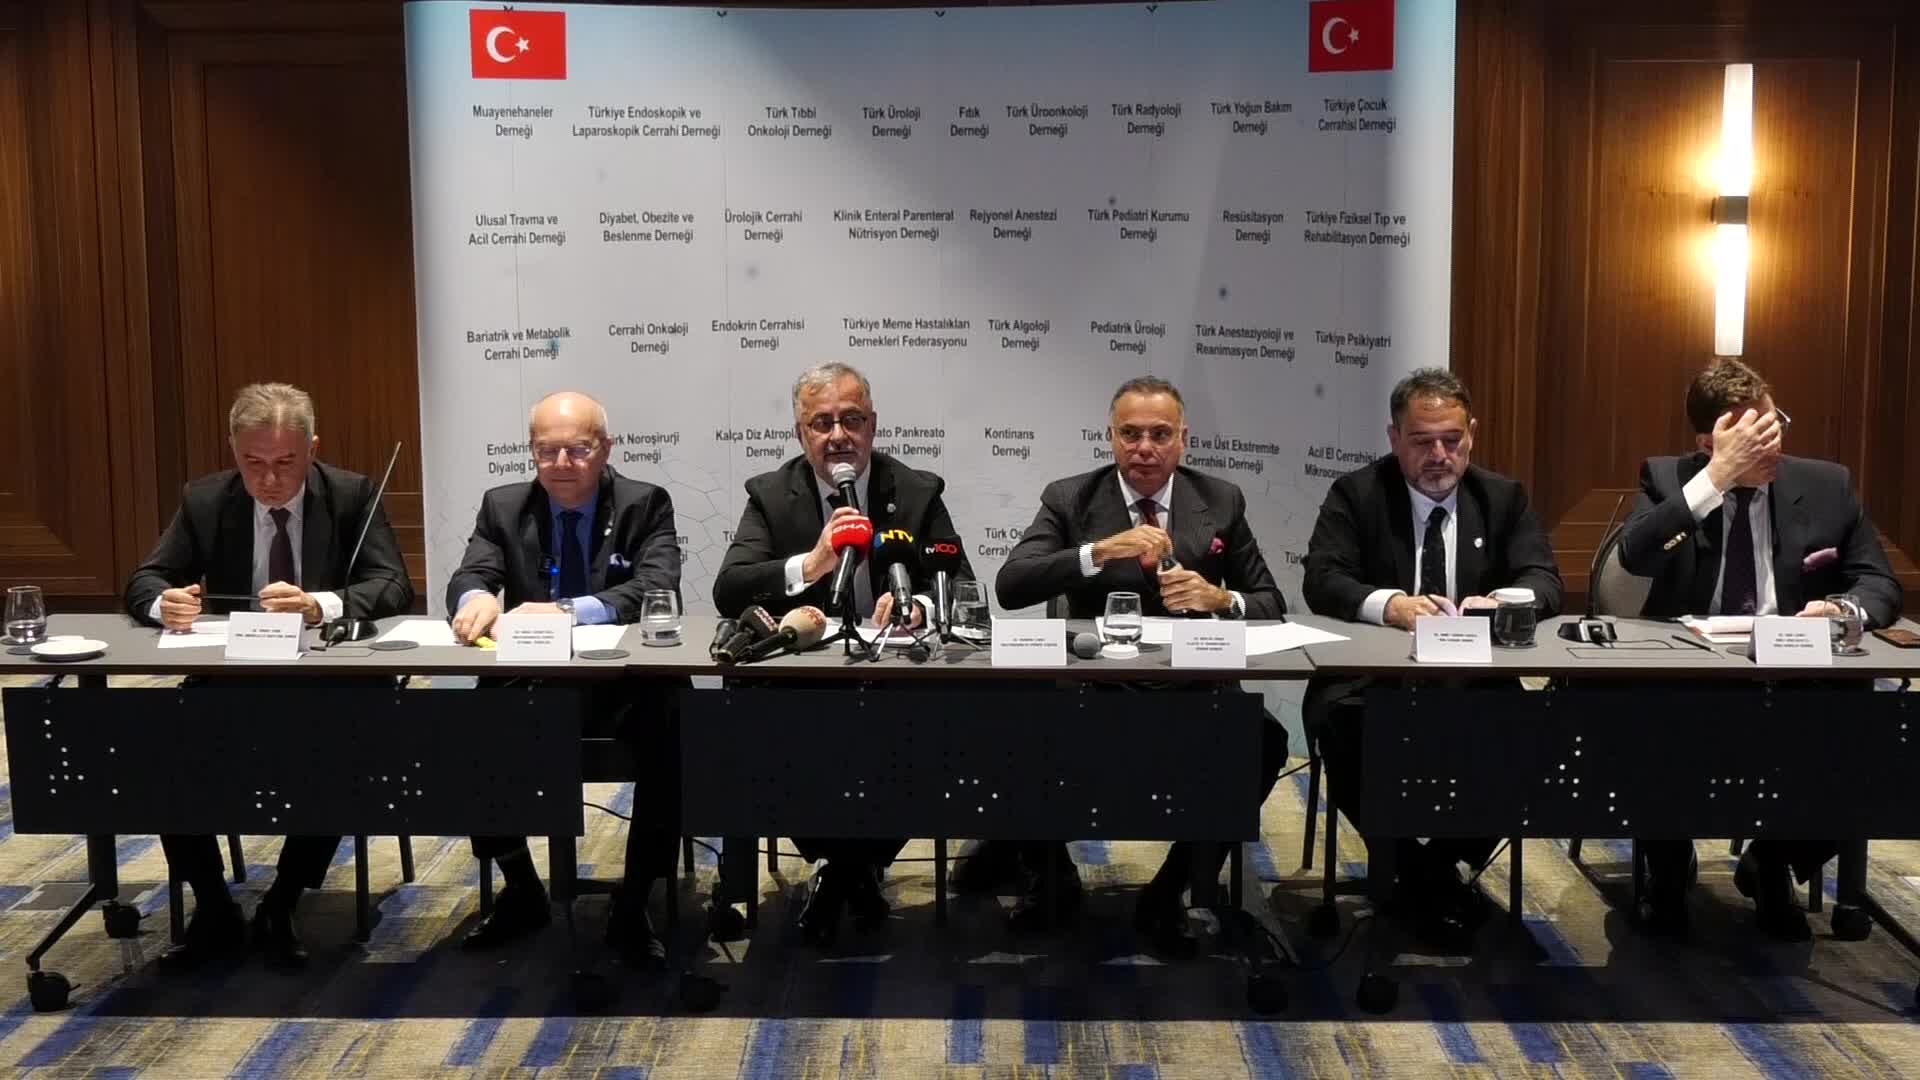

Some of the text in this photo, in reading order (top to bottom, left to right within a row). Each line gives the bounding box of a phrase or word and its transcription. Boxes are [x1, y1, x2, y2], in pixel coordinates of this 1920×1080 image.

[473, 105, 553, 120] Muayenehaneler
[588, 106, 701, 120] Türkiye Endoskopik ve
[766, 107, 788, 118] Türk
[863, 105, 920, 121] Türk Üroloji
[1006, 103, 1088, 120] Türk Üroonkoloji
[1112, 104, 1181, 118] Türk Radyoloji
[1210, 103, 1232, 114] Türk
[1234, 102, 1262, 117] Yoğun
[1324, 98, 1387, 114] Türkiye Çocuk
[496, 124, 533, 139] Derneği
[573, 125, 720, 139] Laparoskopik Cerrahi Derneği
[748, 124, 831, 140] Onkoloji Derneği
[872, 125, 911, 139] Derneği
[950, 124, 989, 139] Derneği
[1029, 124, 1068, 138] Derneği
[1128, 122, 1164, 137] Derneği
[1233, 121, 1267, 136] Derneği
[1318, 118, 1396, 133] Cerrahisi Derneği
[476, 214, 558, 226] Ulusal Travma ve
[600, 211, 694, 226] Diyabet, Obezite ve
[725, 208, 802, 225] Ürolojik Cerrahi
[834, 209, 954, 221] Klinik Enteral Parenteral
[1015, 208, 1057, 221] Anestezi
[1088, 209, 1189, 222] Türk Pediatri Kurumu
[1223, 210, 1283, 226] Resüsitasyon
[1306, 211, 1406, 227] Türkiye Fiziksel Tıp ve
[469, 232, 566, 246] Acil Cerrahi Derneği
[603, 229, 693, 243] Beslenme Derneği
[744, 229, 783, 243] Derneği
[849, 227, 939, 241] Nütrisyon Derneği
[993, 227, 1031, 241] Derneği
[1120, 227, 1157, 243] Derneği
[1236, 229, 1270, 244] Derneği
[1304, 230, 1410, 248] Rehabilitasyon Derneği
[609, 323, 688, 336] Cerrahi Onkoloji
[712, 319, 804, 333] Endokrin Cerrahisi
[843, 318, 970, 332] Türkiye Meme Hastalıkları
[988, 319, 1049, 334] Türk Algoloji
[1091, 320, 1165, 338] Pediatrik Üroloji
[467, 327, 570, 343] Bariatrik ve Metabolik
[1195, 324, 1294, 342] Türk Anesteziyoloji ve
[741, 336, 779, 351] Derneği
[849, 335, 967, 350] Dernekleri Federasyonu
[1002, 337, 1039, 351] Derneği
[1110, 339, 1146, 355] Derneği
[1316, 331, 1391, 350] Türkiye Psikiyatri
[485, 346, 558, 360] Cerrahi Derneği
[631, 341, 669, 355] Derneği
[1196, 343, 1295, 362] Reanimasyon Derneği
[1335, 351, 1368, 368] Derneği
[627, 432, 679, 445] Noroşirurji
[716, 429, 743, 443] Kalça
[746, 429, 761, 440] Diz
[874, 426, 945, 439] ato Pankreato
[985, 428, 1034, 440] Kontinans
[1081, 429, 1102, 441] Türk
[903, 444, 941, 458] Derneği
[1190, 435, 1280, 455] El ve Üst Ekstremite
[624, 450, 661, 464] Derneği
[746, 446, 784, 459] Derneği
[992, 445, 1030, 460] Derneği
[1094, 447, 1113, 459] Dern
[1308, 446, 1324, 458] Acil
[1326, 447, 1334, 459] El
[489, 461, 526, 475] Diyalog
[1185, 454, 1263, 474] Cerrahisi Derneği
[880, 530, 913, 543] NTV
[985, 528, 1007, 538] Türk
[978, 545, 1011, 556] Cerrah
